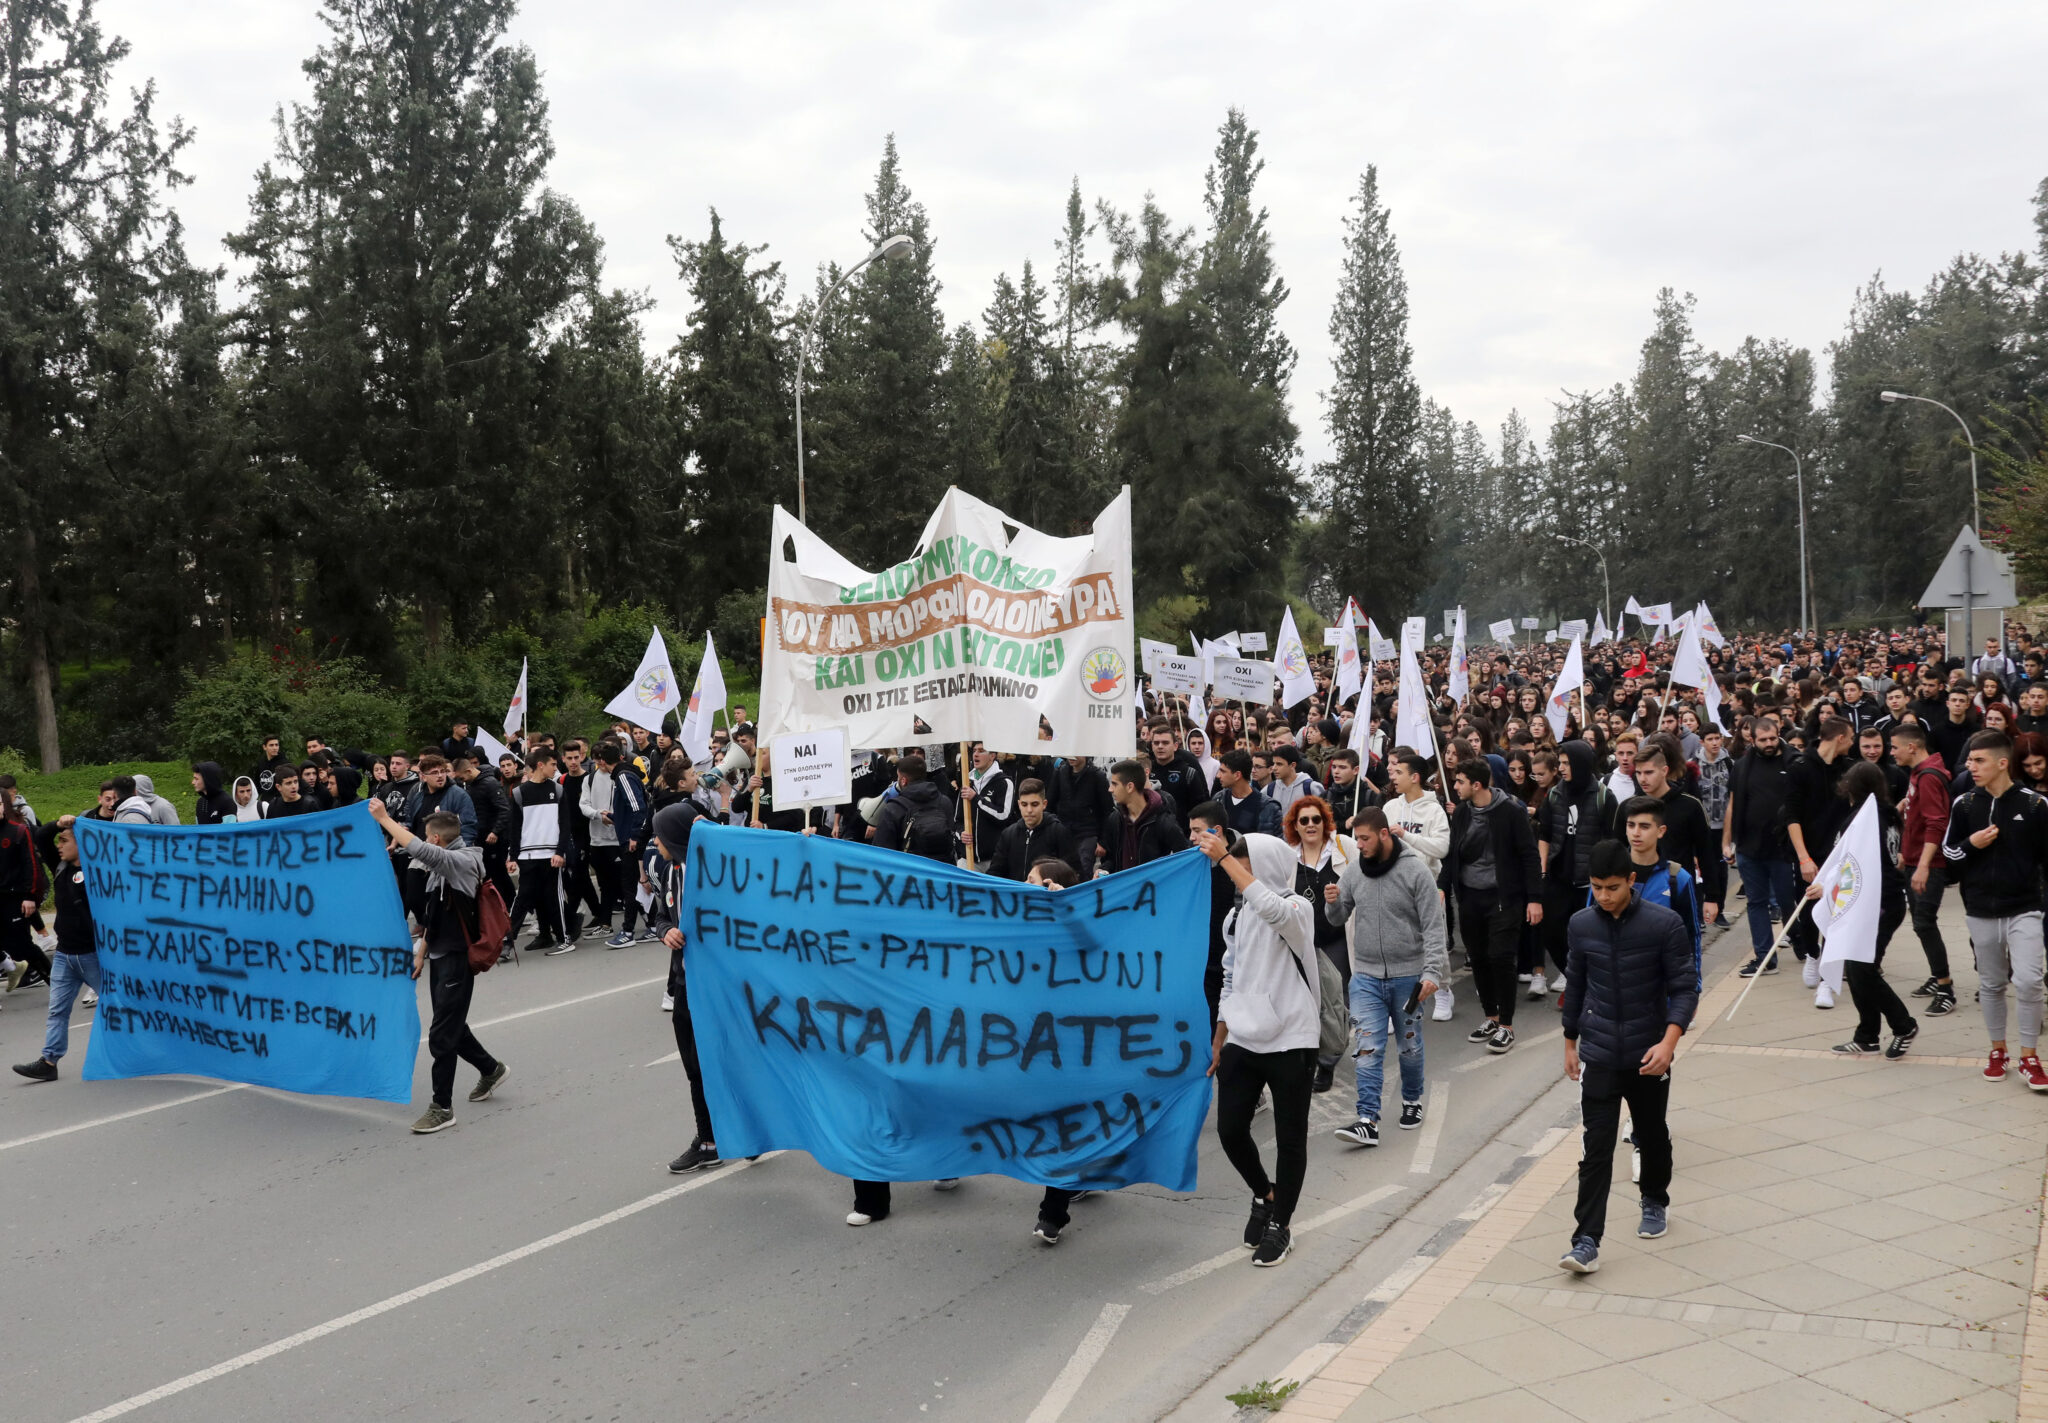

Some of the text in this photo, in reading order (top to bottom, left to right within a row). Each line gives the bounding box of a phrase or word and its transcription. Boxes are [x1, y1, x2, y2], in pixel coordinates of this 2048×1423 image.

[829, 613, 864, 649] ΝΑ
[815, 653, 866, 691] ΚΑΙ
[875, 640, 925, 682] ΟΧΙ
[1170, 662, 1186, 671] ΟΧΙ
[1235, 666, 1252, 676] ΟΧΙ
[843, 693, 872, 715] ΟΧΙ
[876, 686, 909, 710] ΣΤΙΣ
[1088, 703, 1123, 719] ΠΣΕΜ
[794, 743, 817, 759] ΝΑΙ
[82, 828, 119, 865] ΟΧΙ
[87, 863, 315, 917] ΑΝΑ ΤΕΤΡΑΜΗΝΟ
[696, 844, 1157, 922] NU LA EXAMENE LA
[123, 926, 213, 965] EXAMS
[225, 936, 288, 973] PER
[694, 905, 1163, 993] FIECARE PATRU LUNI
